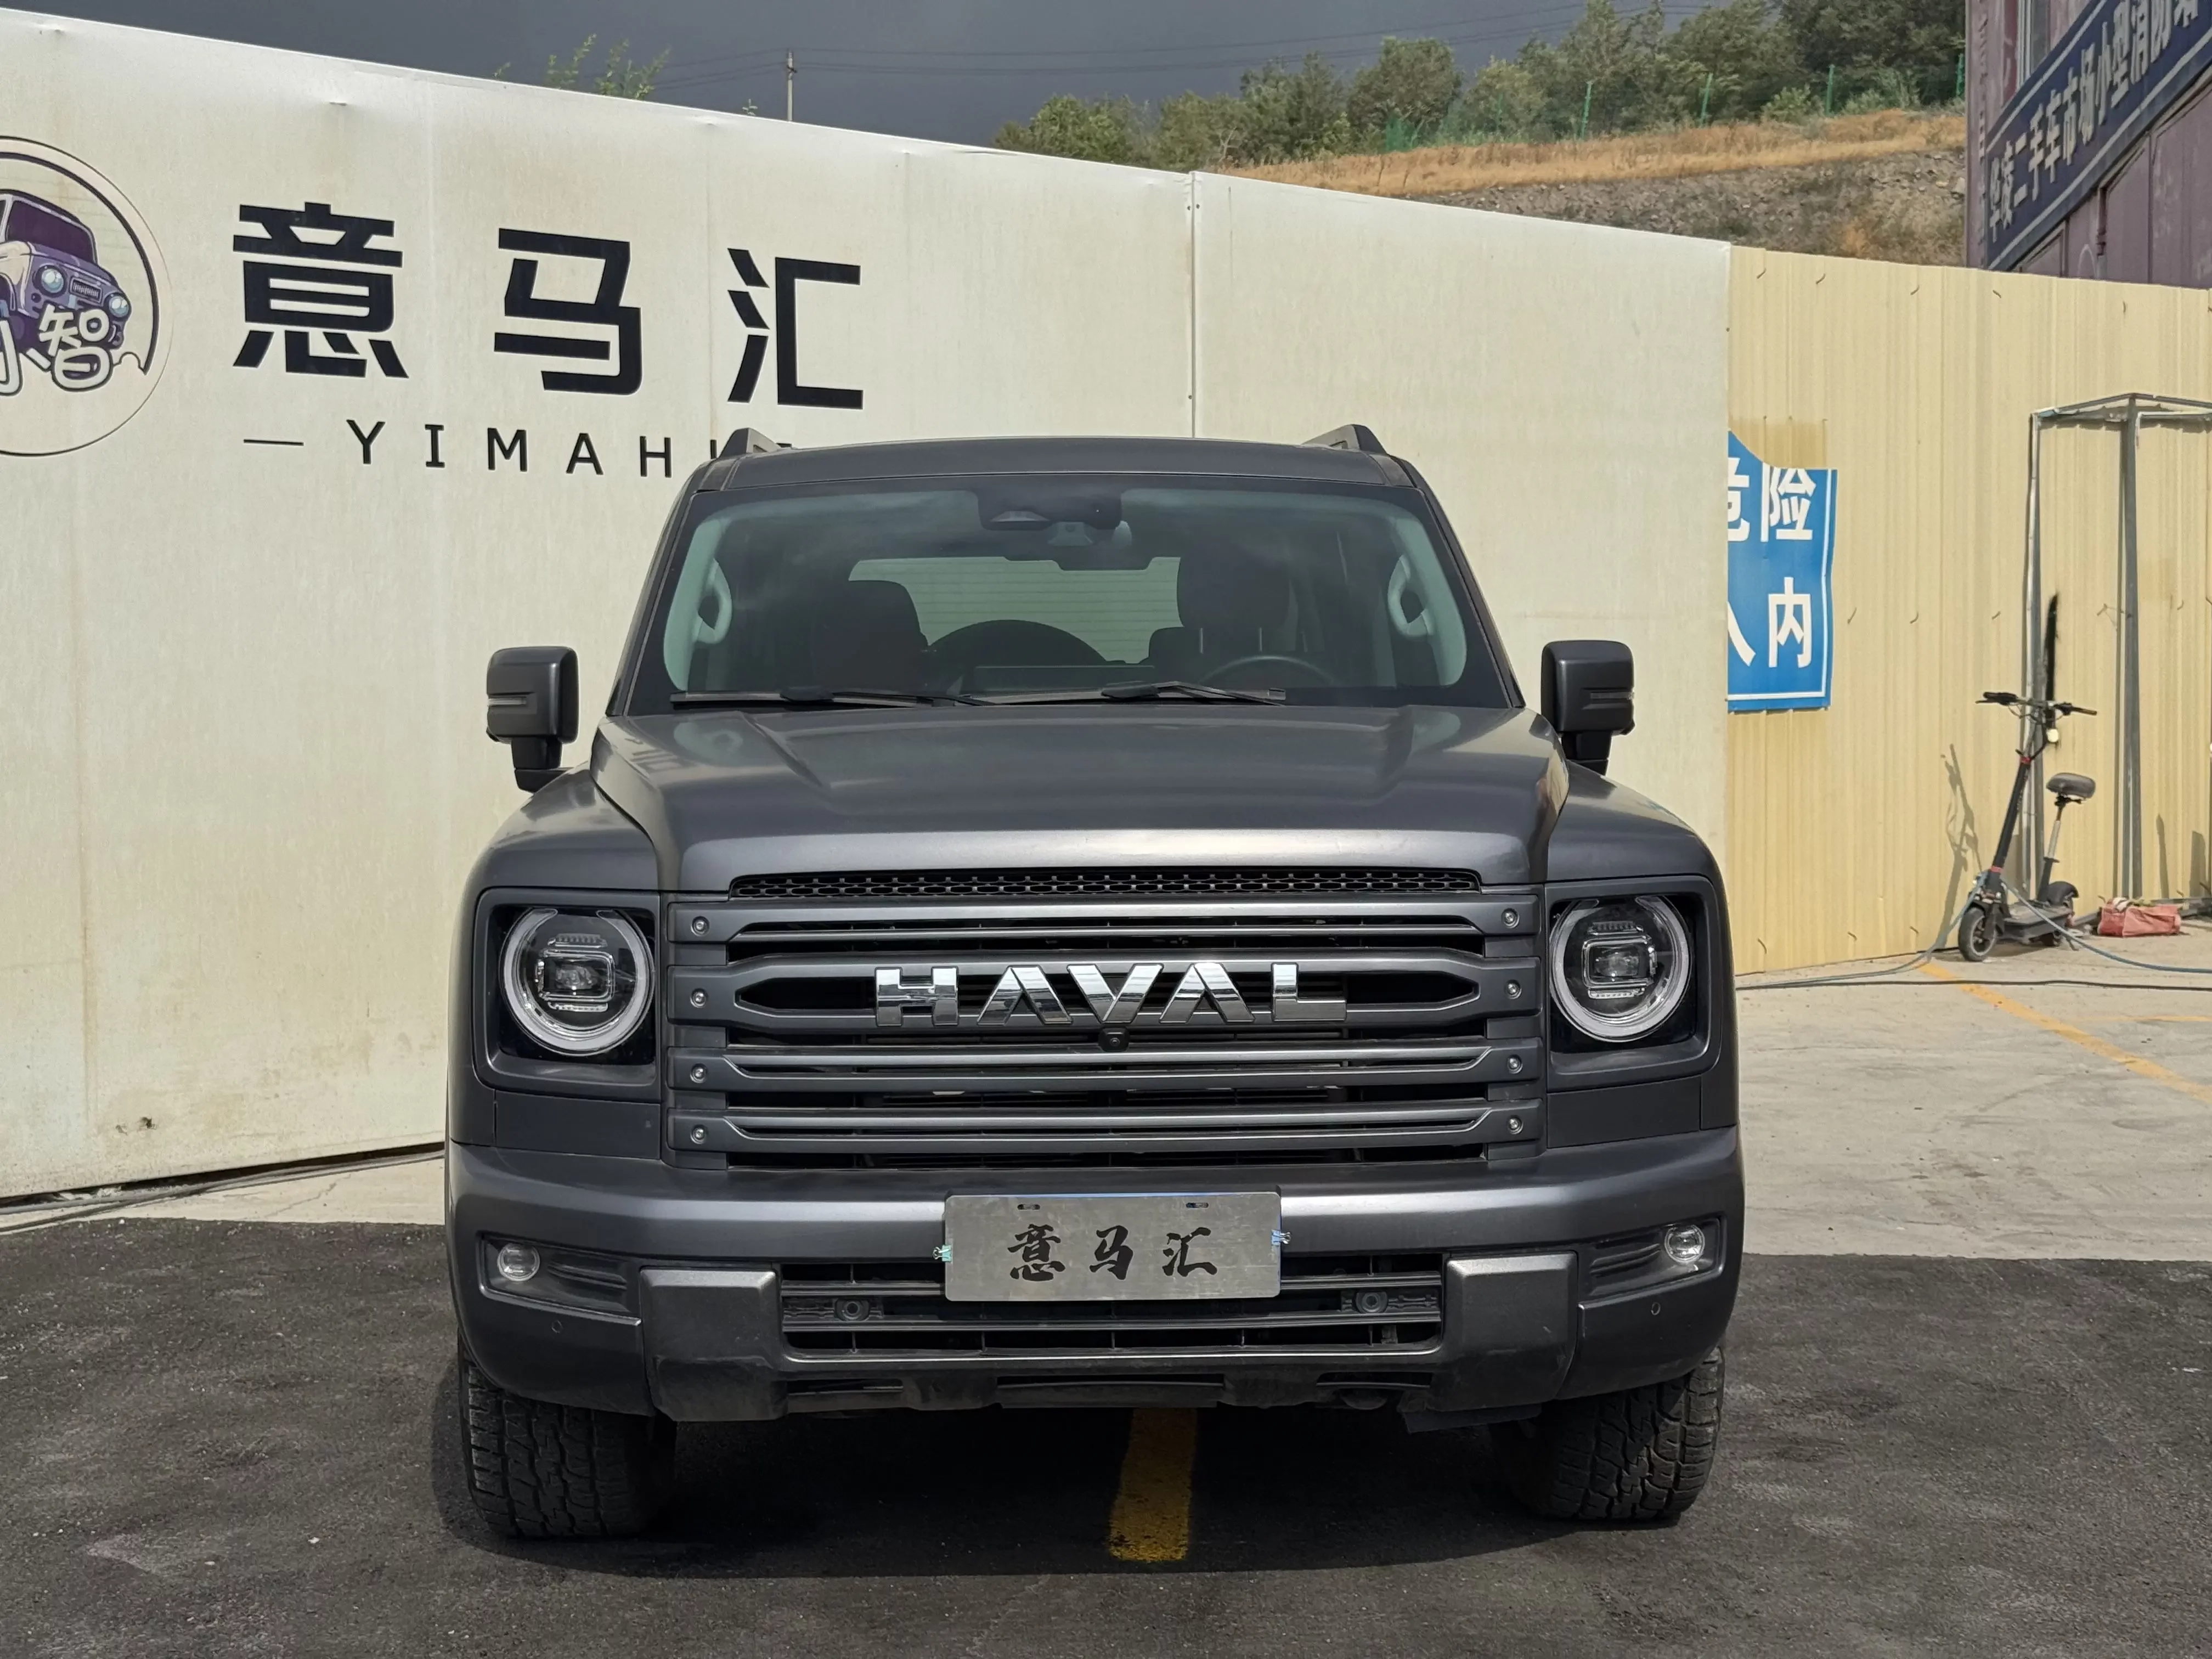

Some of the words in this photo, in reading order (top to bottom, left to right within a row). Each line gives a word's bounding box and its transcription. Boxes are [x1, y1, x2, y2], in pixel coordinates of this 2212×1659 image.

[233, 201, 864, 410] 意马汇
[346, 419, 792, 478] YIMAH
[876, 962, 1347, 1026] HAVAL
[1007, 1223, 1217, 1282] 意马汇
